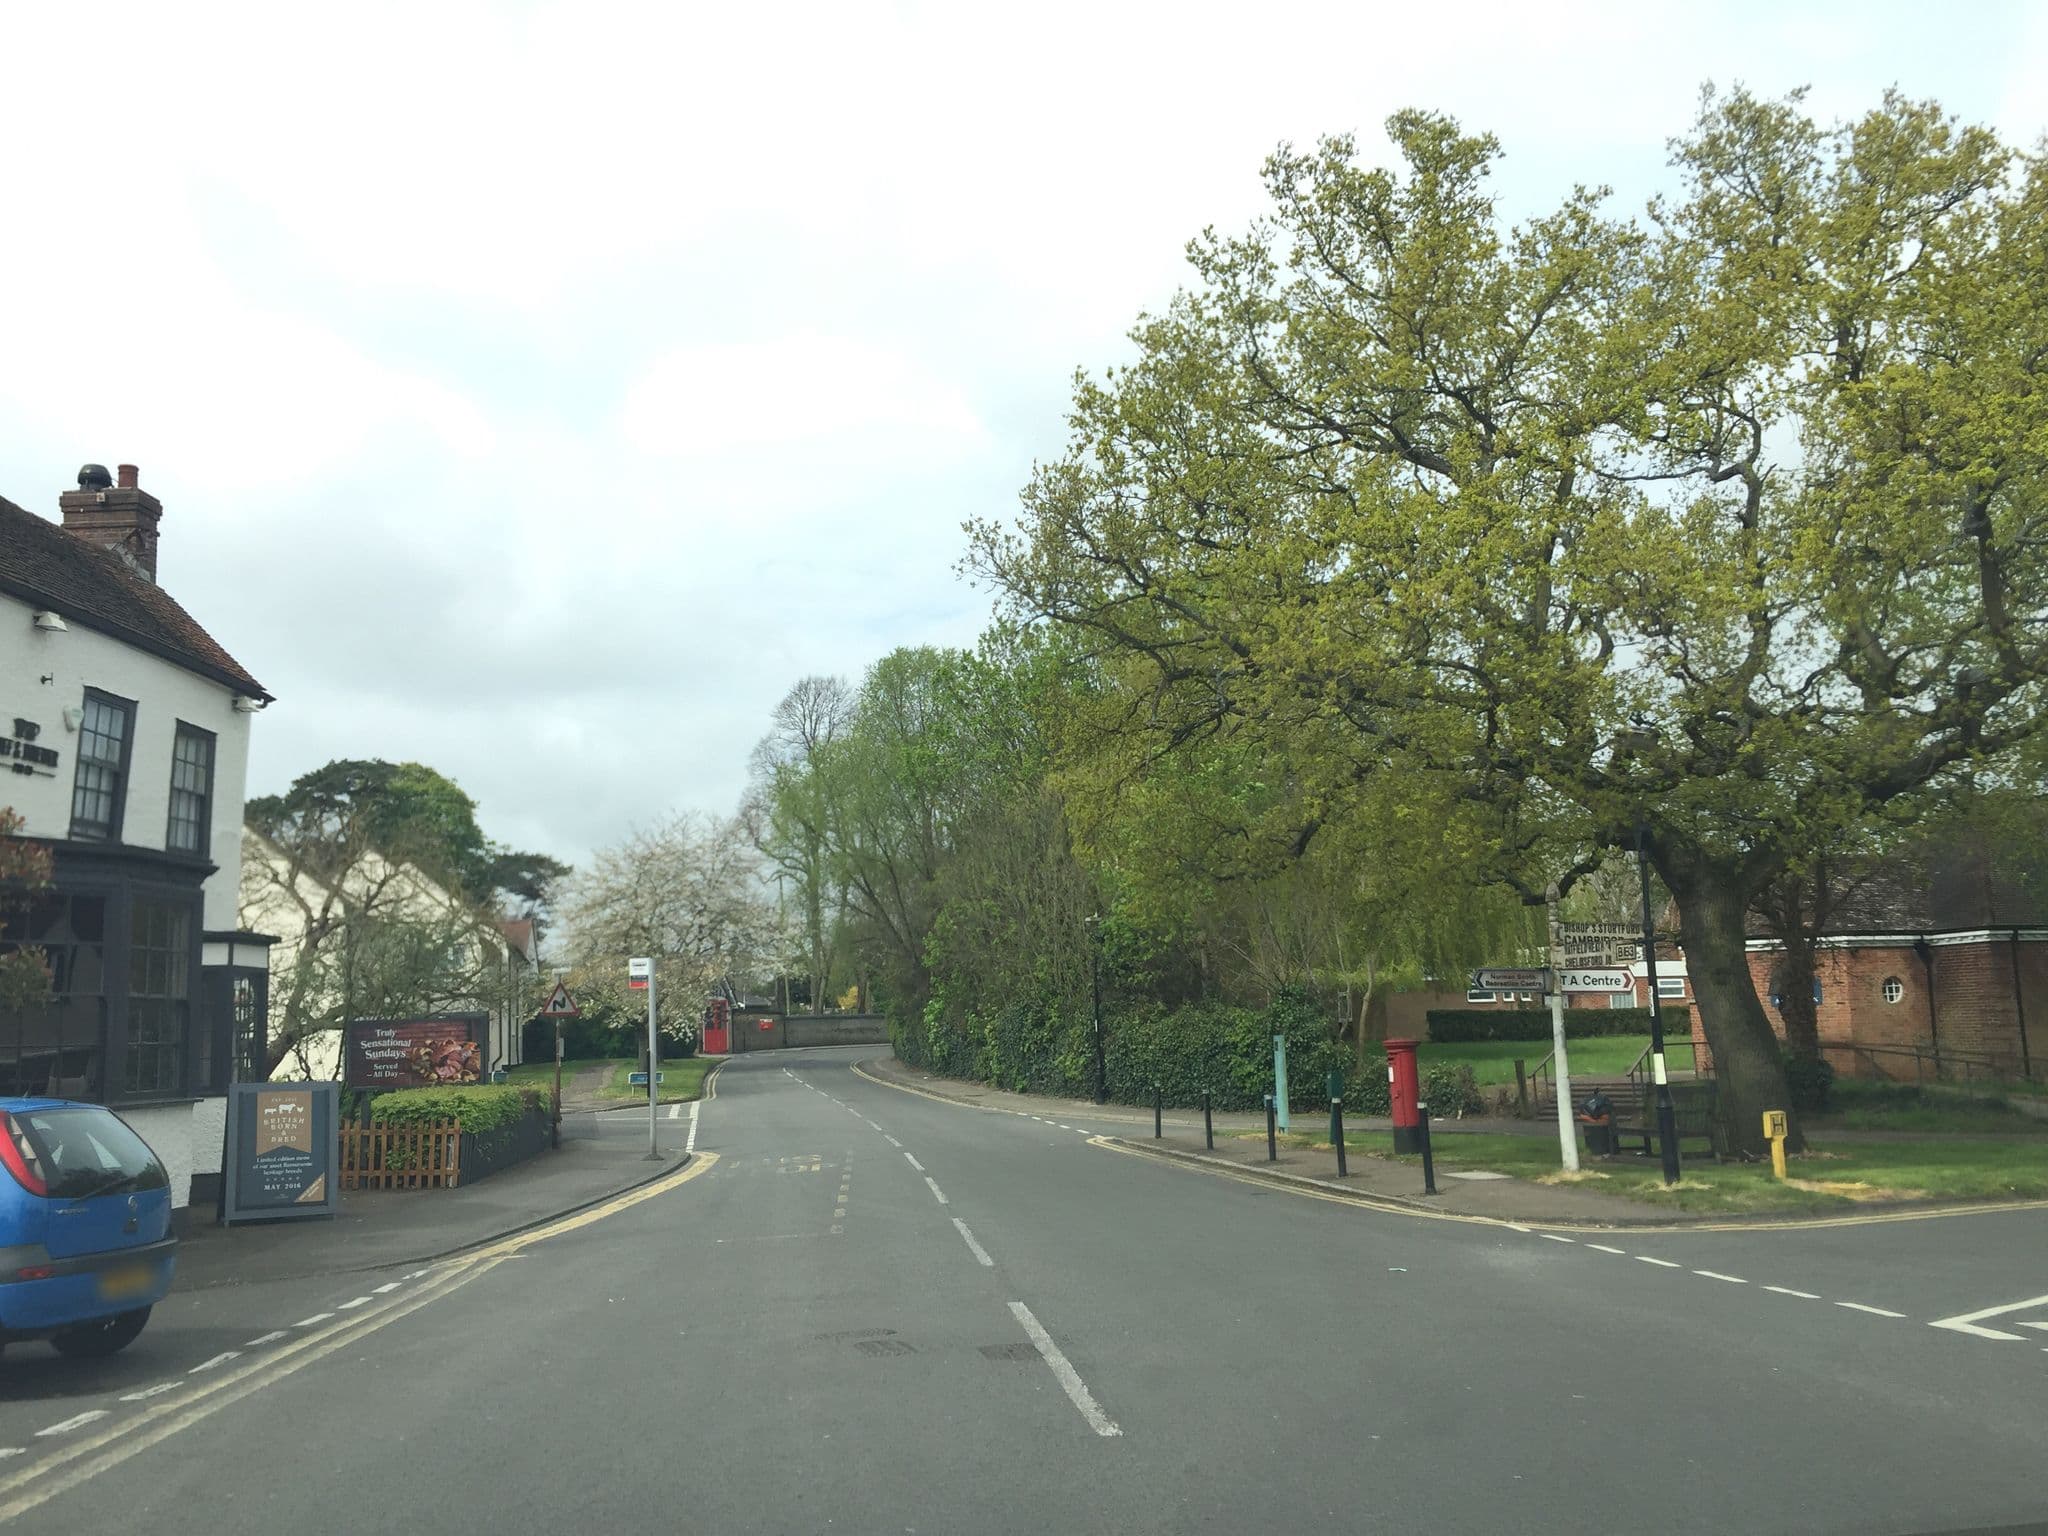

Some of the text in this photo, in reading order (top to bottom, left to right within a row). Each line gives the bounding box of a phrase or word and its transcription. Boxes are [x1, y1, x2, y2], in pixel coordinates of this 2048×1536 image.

[1598, 923, 1640, 935] STORTFORD
[1583, 975, 1621, 985] Centre
[375, 1029, 396, 1038] Truly
[360, 1039, 411, 1049] Sensational
[365, 1048, 406, 1059] Sundays
[264, 1117, 304, 1126] BRITISH
[1772, 1116, 1784, 1133] H
